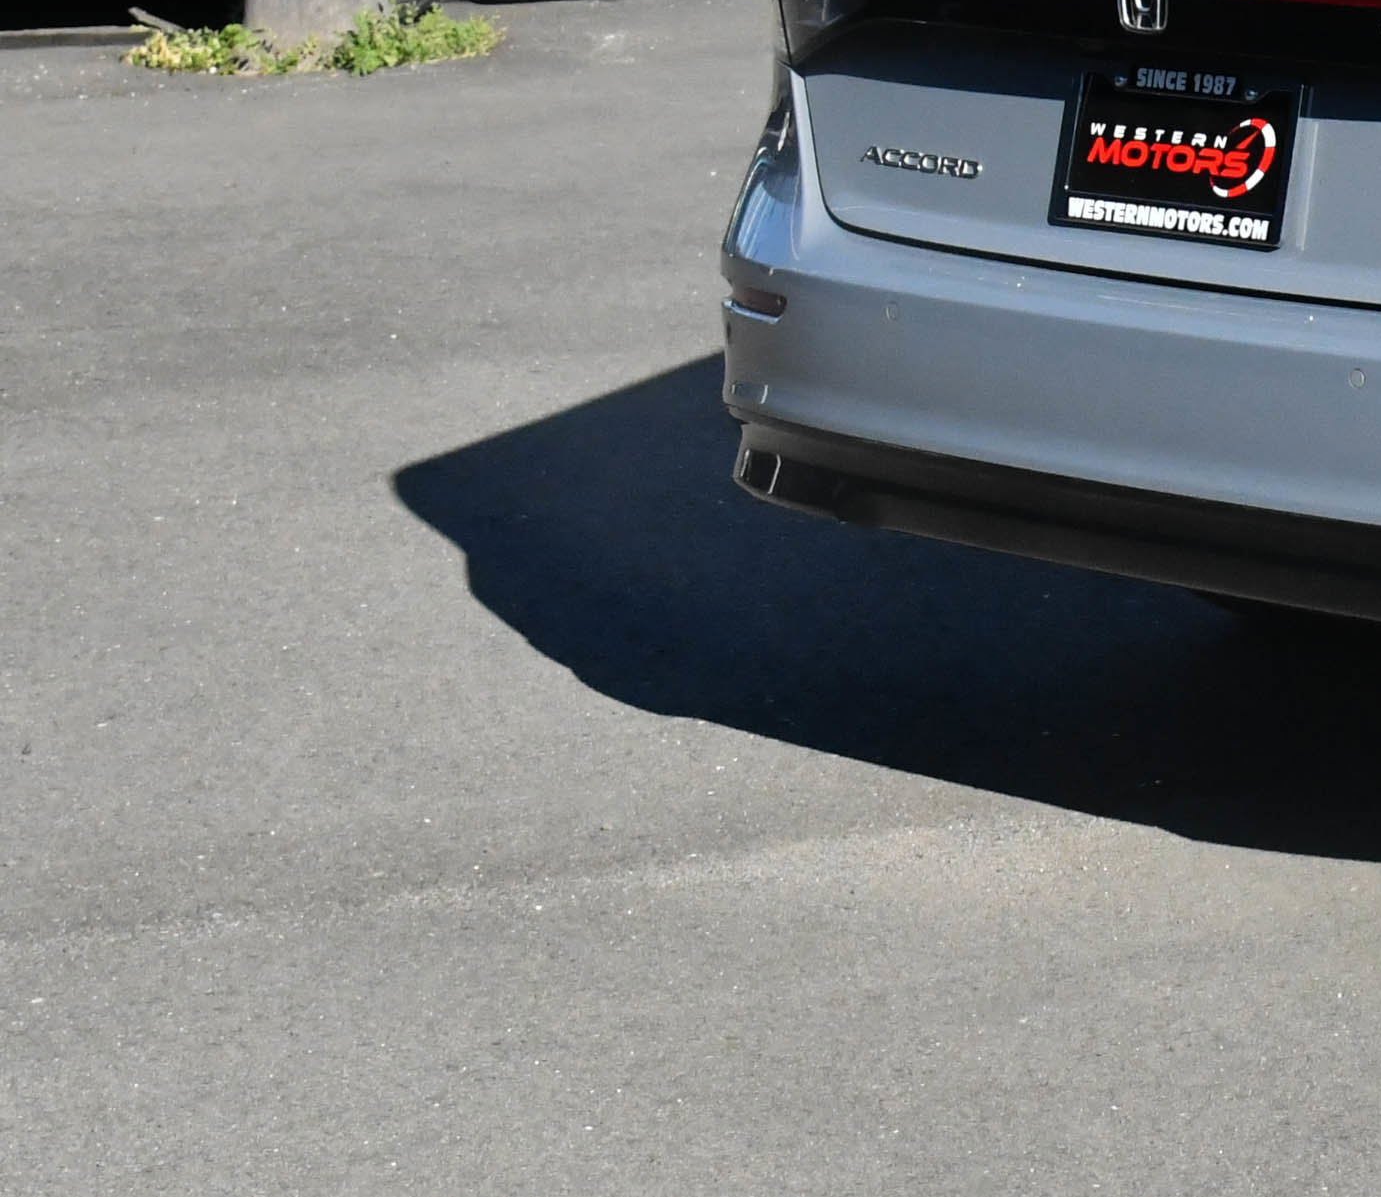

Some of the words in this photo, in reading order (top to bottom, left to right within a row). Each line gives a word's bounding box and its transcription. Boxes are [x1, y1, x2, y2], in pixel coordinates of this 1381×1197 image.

[1135, 67, 1187, 91] SINCE
[1193, 73, 1237, 97] 1987
[1089, 122, 1228, 150] WESTERN
[859, 144, 983, 179] ACCORD
[1086, 136, 1251, 179] MOTORS
[1067, 196, 1270, 241] WESTERNMOTORS.COM
